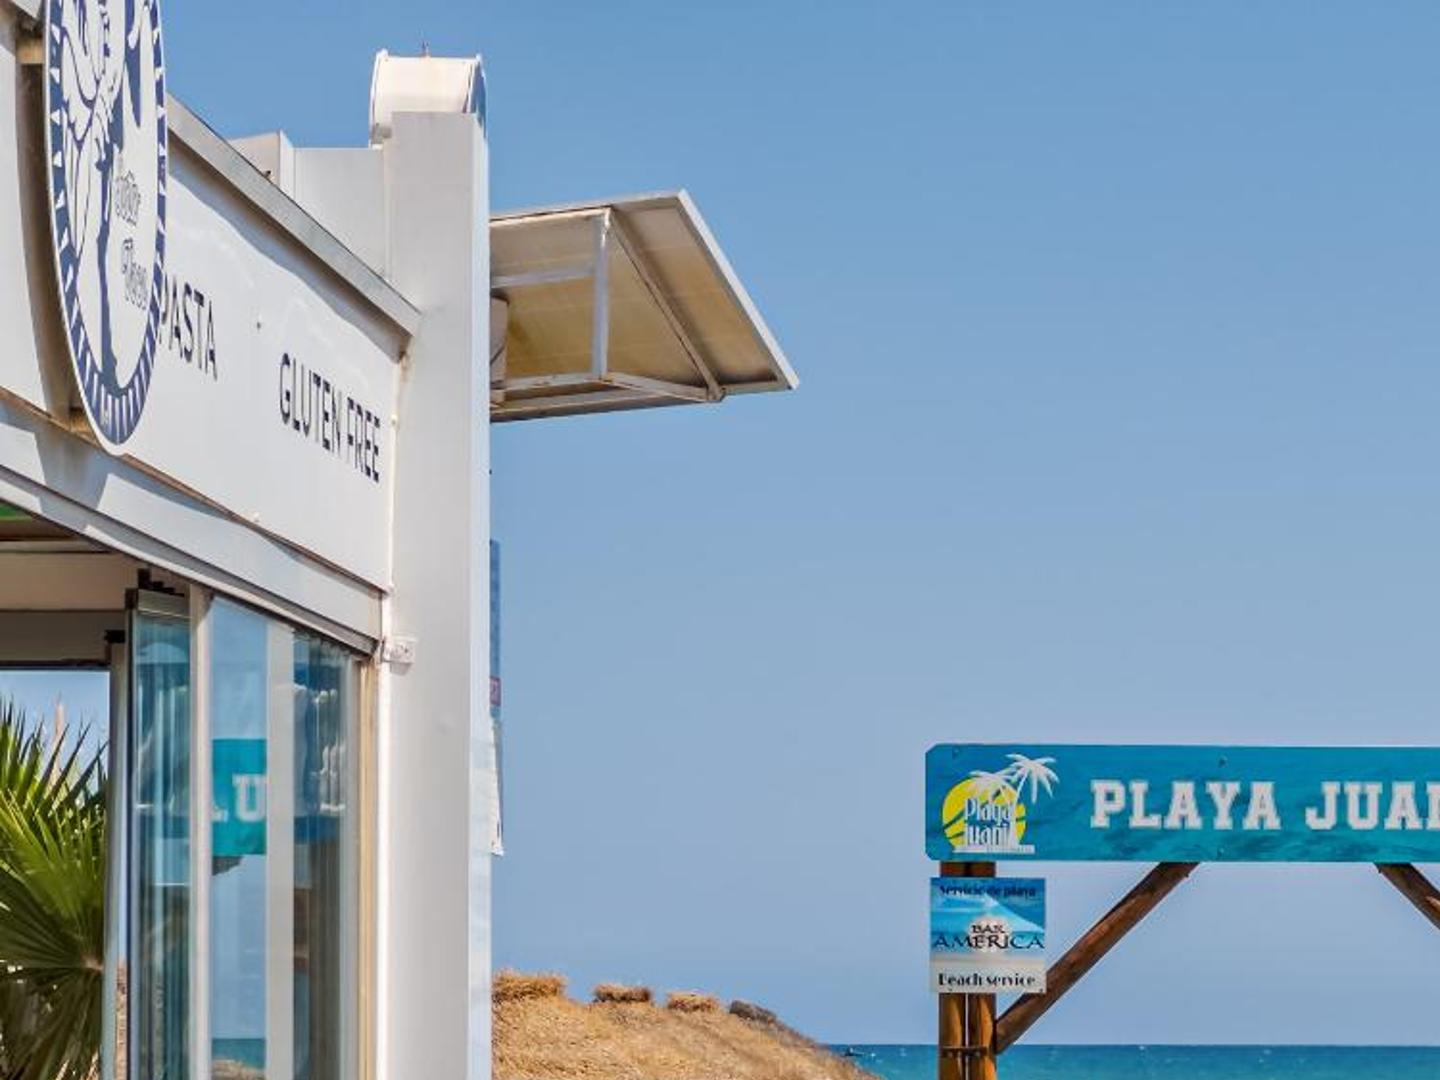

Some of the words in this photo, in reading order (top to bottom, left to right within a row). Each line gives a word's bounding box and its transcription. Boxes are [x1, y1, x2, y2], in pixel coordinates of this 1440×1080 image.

[158, 272, 217, 381] PASTA
[279, 353, 342, 458] GLUTEN
[346, 397, 380, 483] FREE
[964, 797, 1013, 827] Playa
[1090, 779, 1282, 830] PLAYA
[933, 934, 1045, 949] AMERICA
[971, 924, 1006, 934] BAR
[938, 972, 983, 987] Beach
[986, 973, 1036, 987] service
